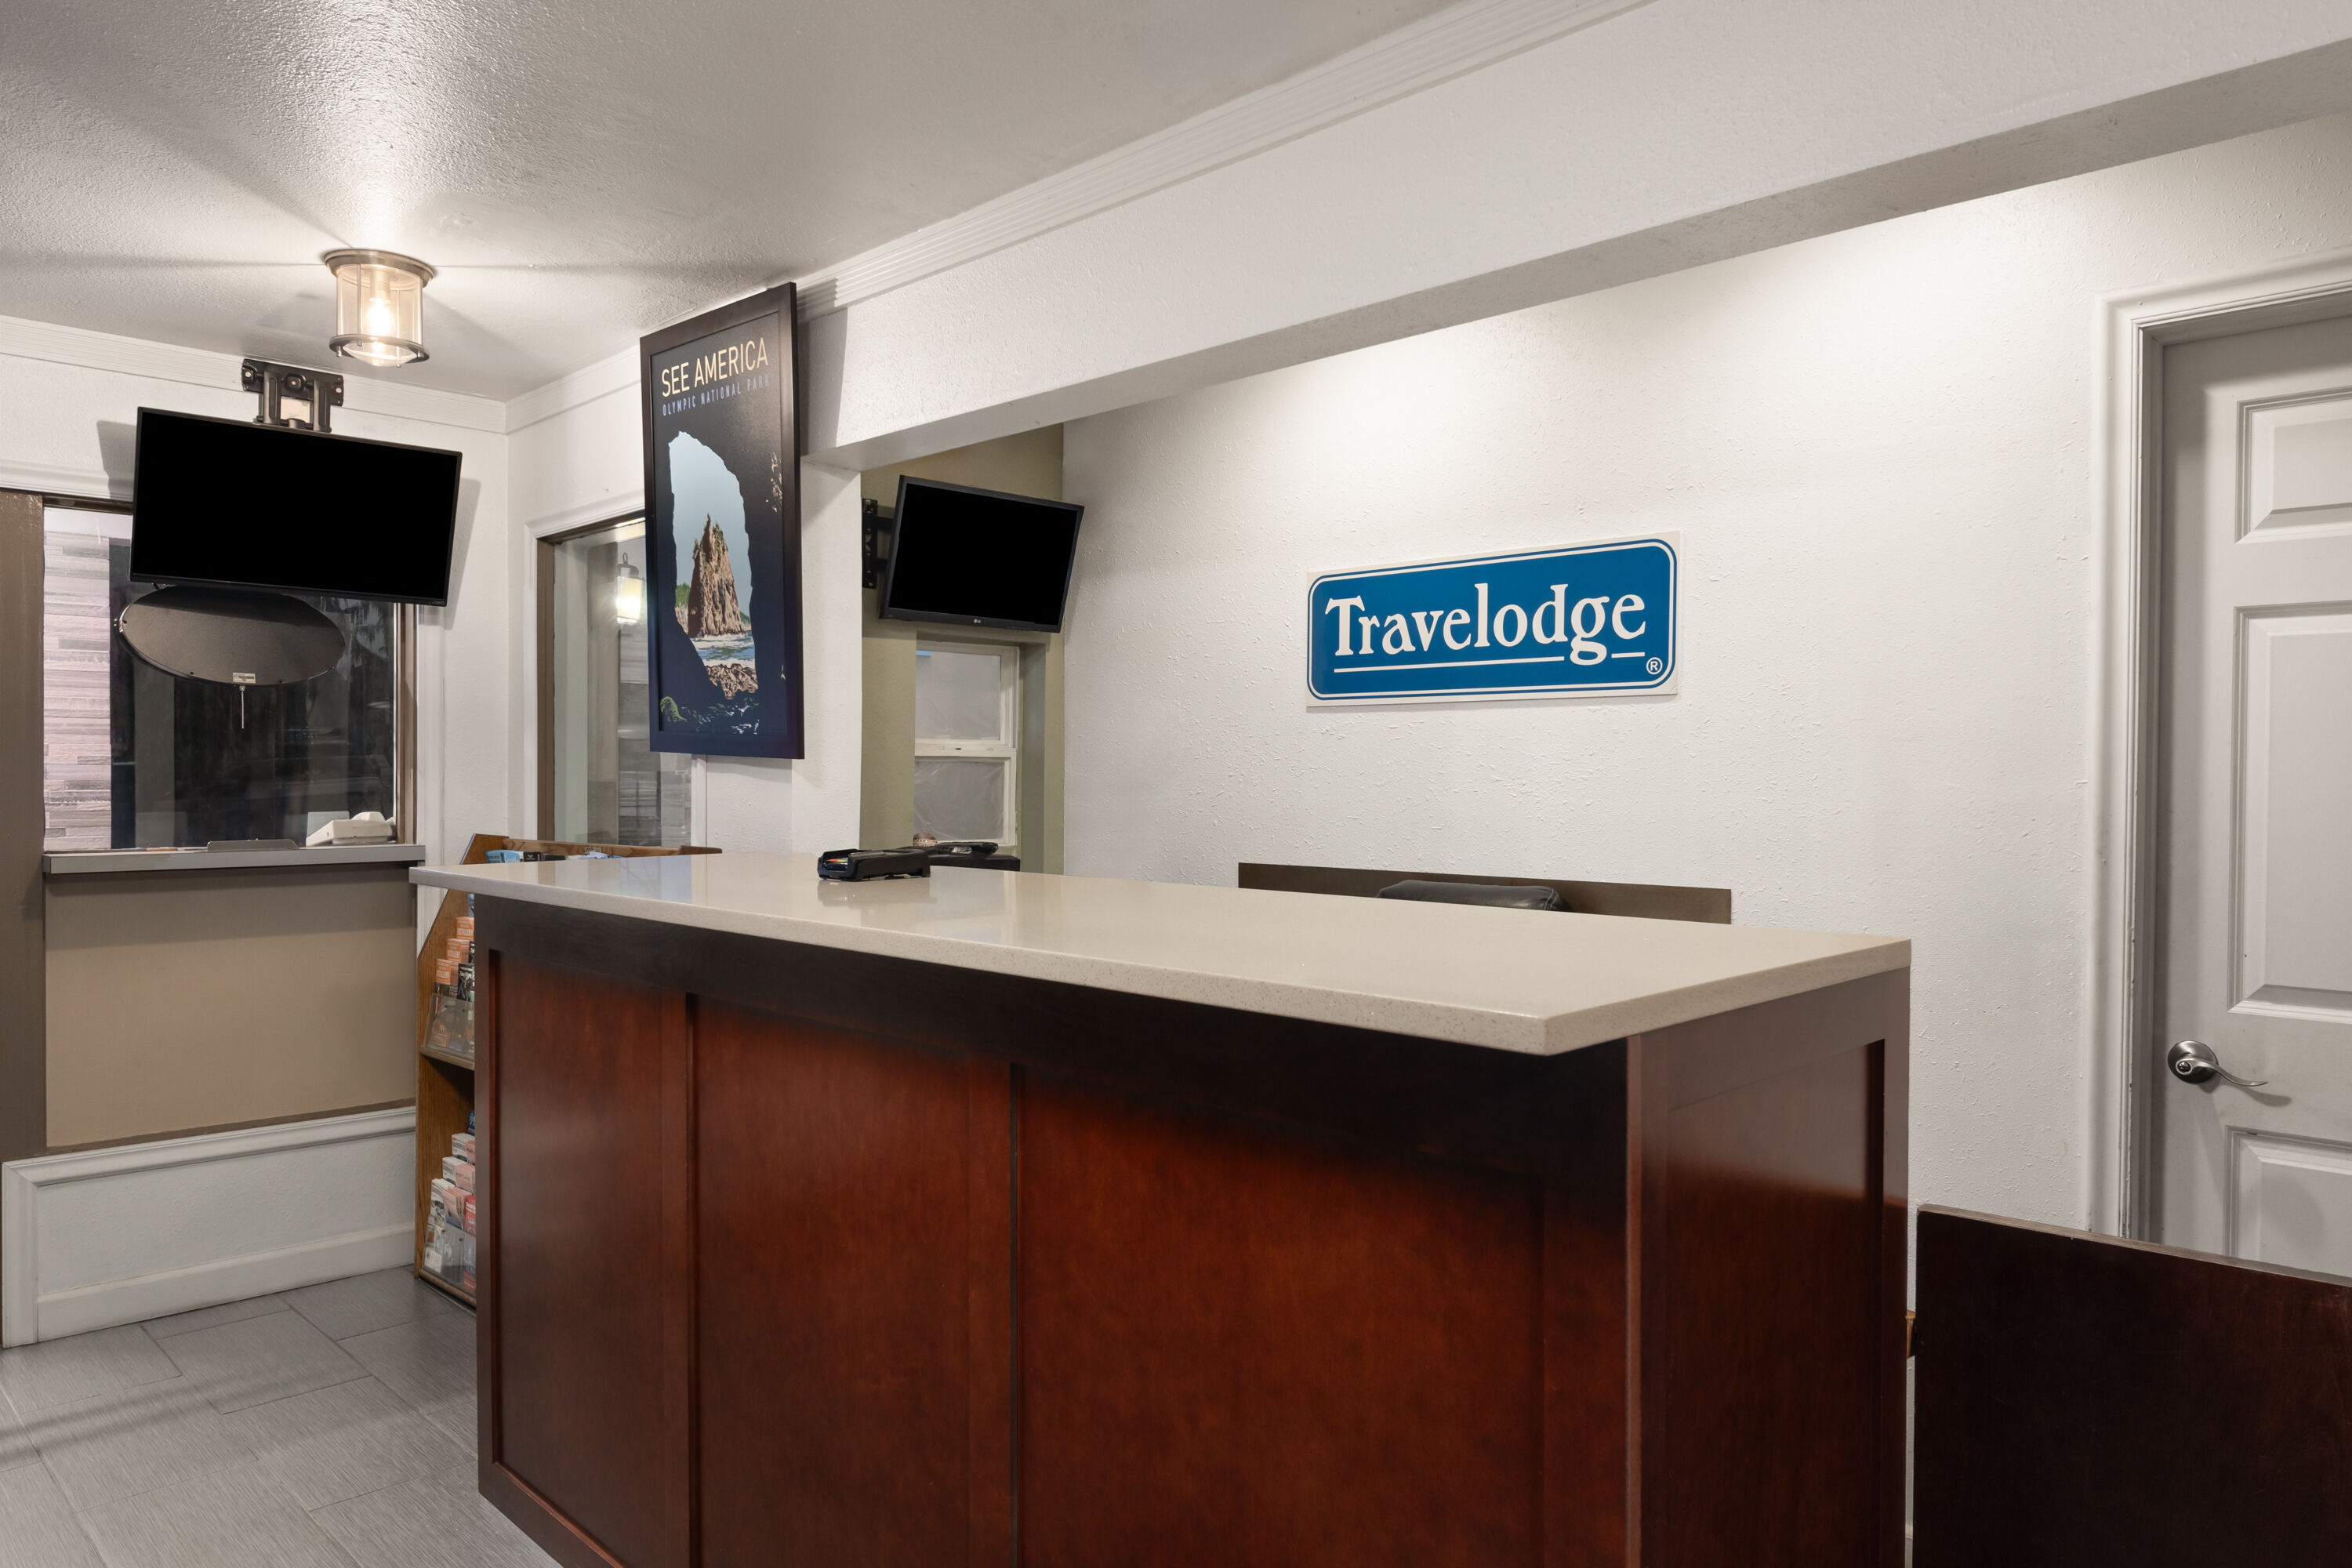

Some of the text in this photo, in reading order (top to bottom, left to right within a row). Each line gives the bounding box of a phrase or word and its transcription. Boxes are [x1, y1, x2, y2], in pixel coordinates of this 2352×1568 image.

[661, 337, 768, 397] SEE AMERICA
[662, 373, 770, 416] OLYMPIC NATIONAL PARK
[1325, 583, 1646, 665] Travelodge
